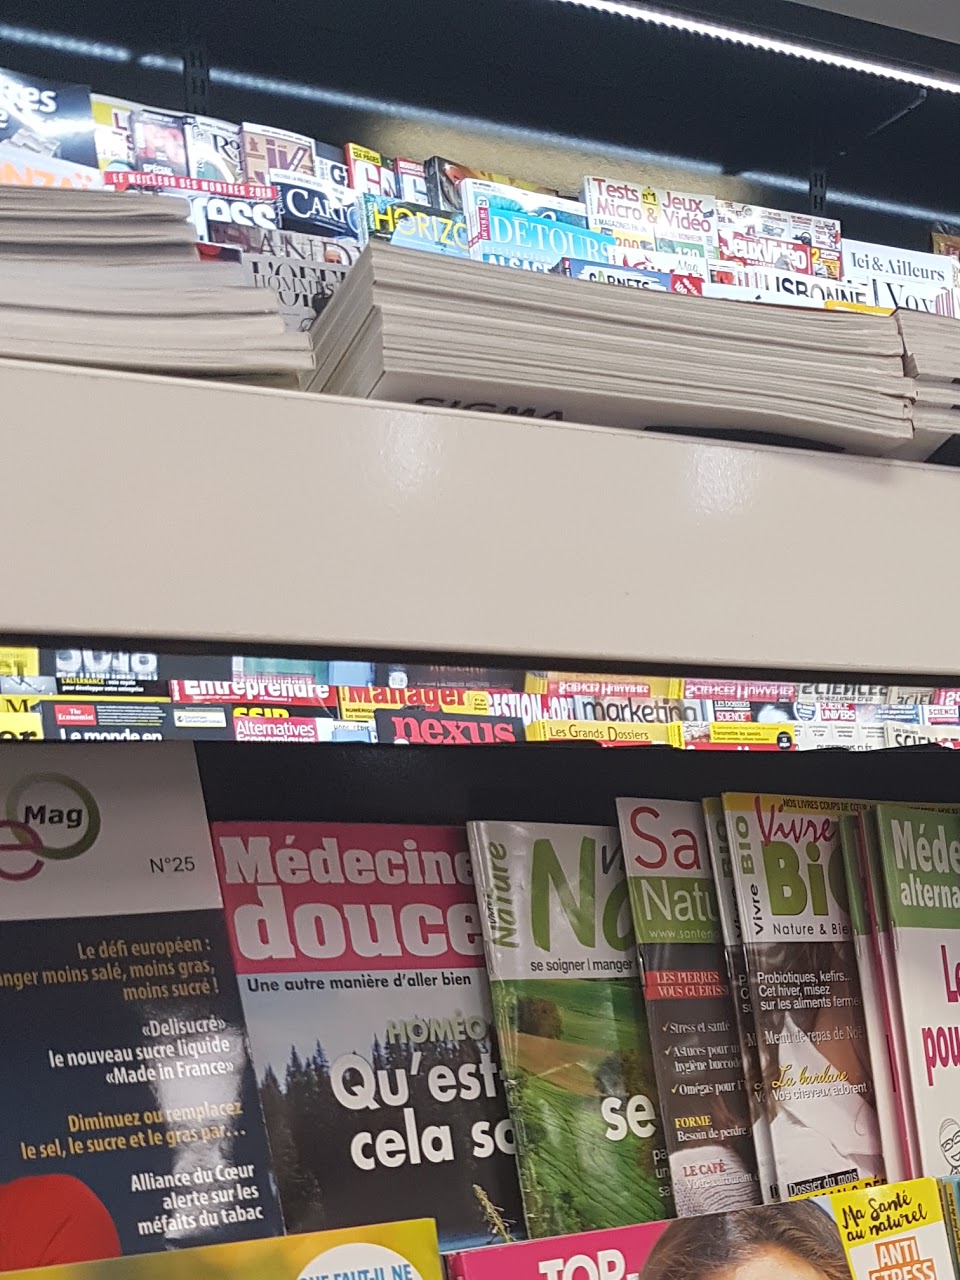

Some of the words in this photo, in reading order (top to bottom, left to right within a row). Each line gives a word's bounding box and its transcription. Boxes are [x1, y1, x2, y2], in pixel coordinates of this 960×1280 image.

[593, 178, 639, 202] Tests
[662, 192, 704, 213] Jeux
[596, 198, 642, 221] Micro
[647, 210, 658, 223] &
[662, 211, 712, 234] Vidéo
[235, 719, 315, 738] Alternatives
[392, 716, 515, 743] nexus
[550, 728, 567, 739] Les
[568, 724, 604, 741] Grands
[607, 726, 649, 742] Dossiers
[24, 804, 83, 828] Mag
[755, 796, 837, 847] Vivre
[150, 856, 195, 873] N°25
[233, 885, 486, 960] douce
[78, 942, 95, 960] Le
[100, 941, 128, 957] défi
[131, 938, 202, 958] européen
[530, 960, 544, 971] se
[546, 958, 585, 973] soigner
[593, 959, 633, 972] manger
[248, 978, 279, 992] Une
[284, 976, 325, 990] autre
[329, 972, 389, 990] manière
[393, 972, 438, 988] d'aller
[442, 972, 472, 986] bien
[757, 972, 818, 985] Probiotiques,
[49, 1051, 64, 1068] le
[68, 1049, 133, 1066] nouveau
[136, 1044, 175, 1060] sucre
[177, 1038, 230, 1059] liquide
[675, 1116, 712, 1128] FORME
[350, 1107, 455, 1171] cela
[131, 1172, 190, 1192] Alliance
[194, 1170, 212, 1184] du
[138, 1212, 196, 1236] méfaits
[200, 1211, 218, 1226] du
[221, 1204, 264, 1223] tabac
[878, 1240, 917, 1267] ANTI
